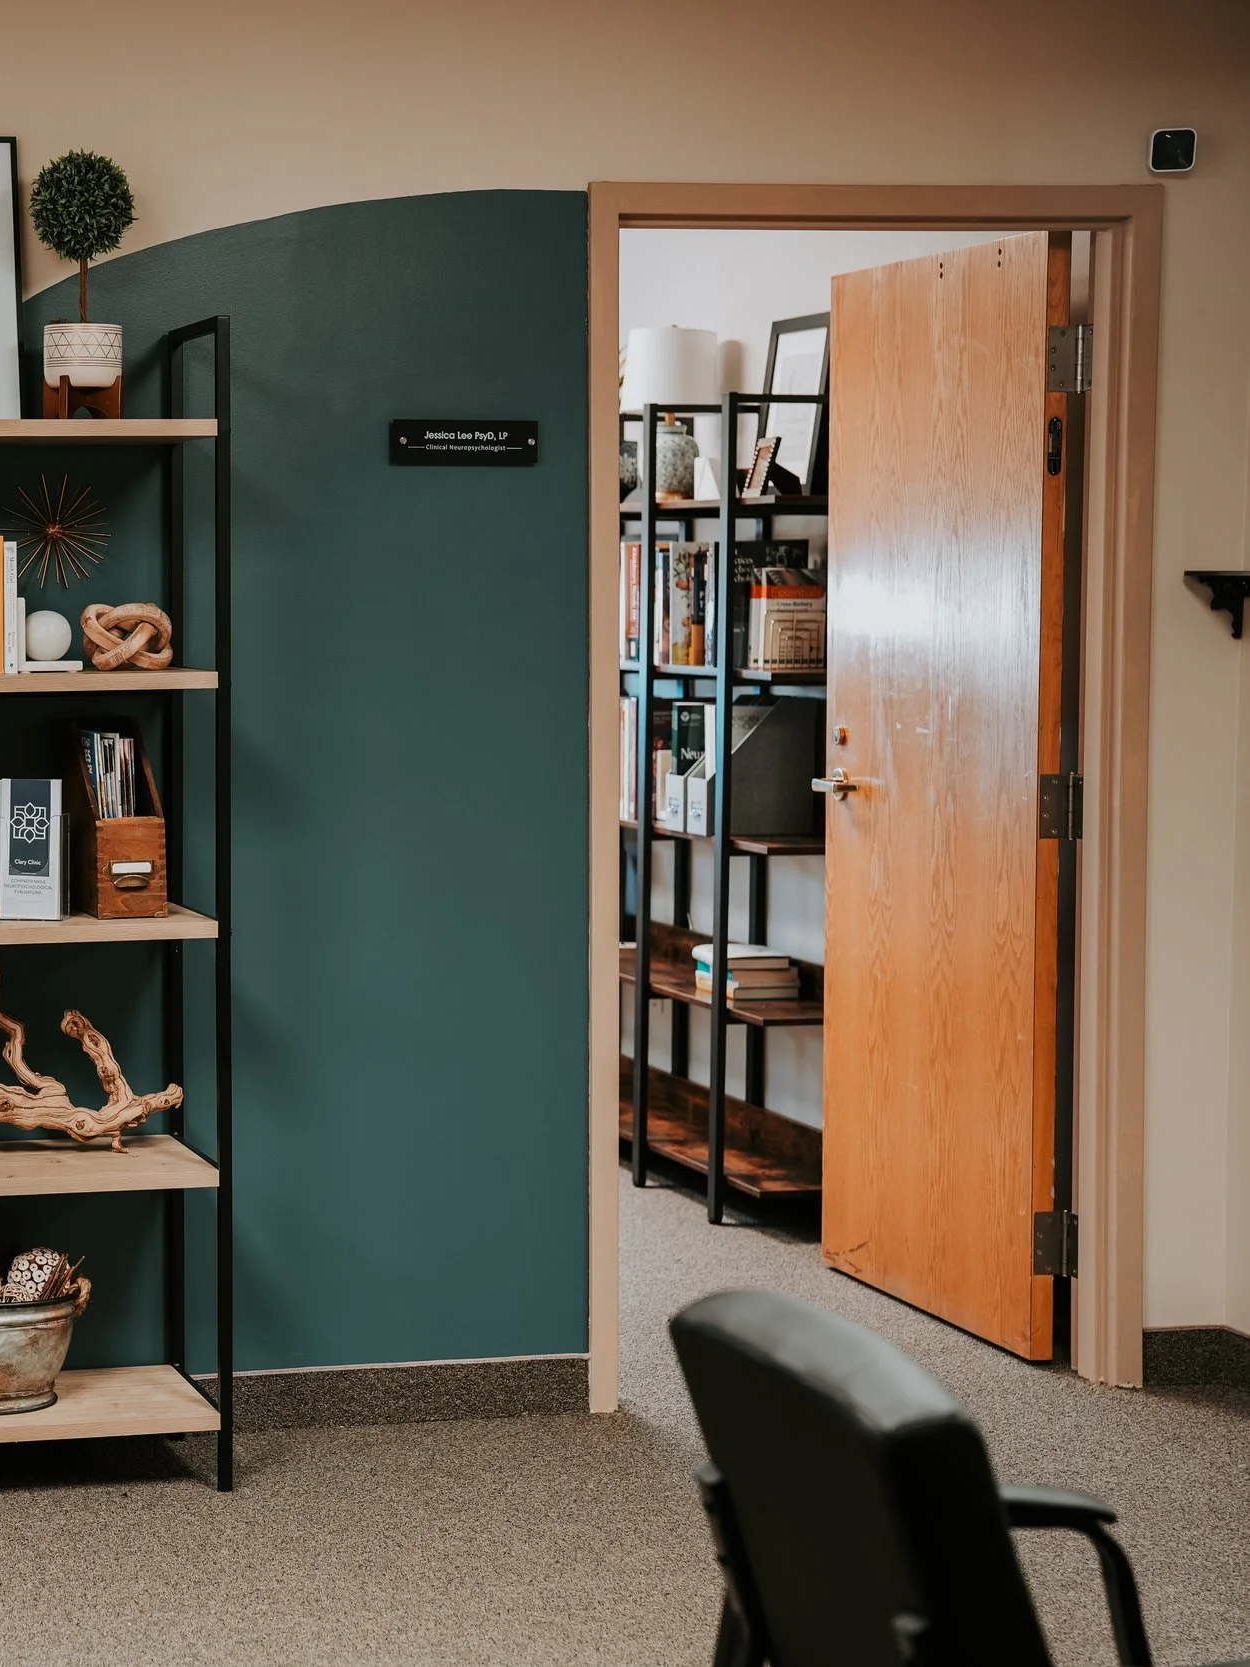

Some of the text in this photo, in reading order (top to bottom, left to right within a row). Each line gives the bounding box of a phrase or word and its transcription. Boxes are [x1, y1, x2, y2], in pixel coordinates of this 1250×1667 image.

[424, 431, 508, 441] Jessica Lee PsyD, LP
[449, 444, 506, 452] Neuropsychologist
